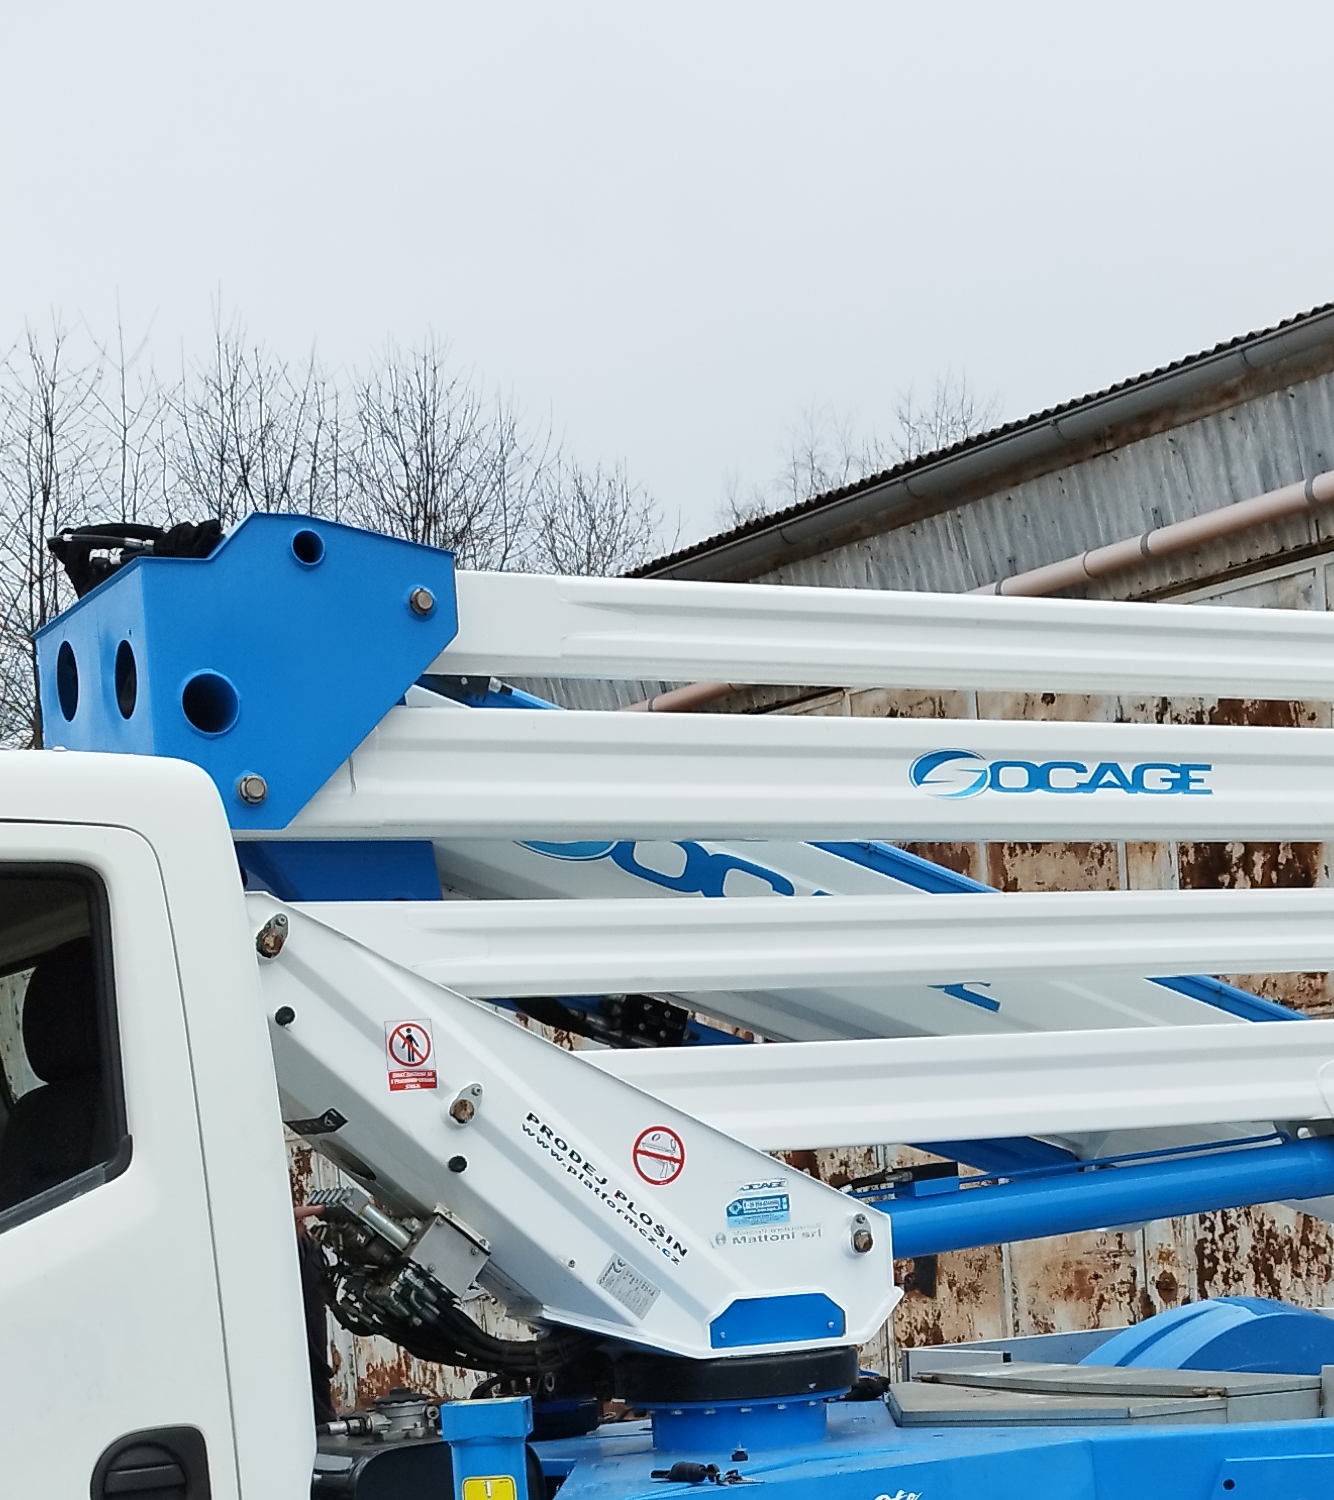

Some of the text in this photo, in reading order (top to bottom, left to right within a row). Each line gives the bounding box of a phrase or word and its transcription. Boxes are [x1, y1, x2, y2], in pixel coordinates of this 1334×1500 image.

[909, 747, 1214, 800] SOCAGE
[521, 1122, 682, 1267] www.platformcz.cz
[525, 1111, 689, 1258] PRODEJ PLOŠIN
[732, 1228, 822, 1245] Mattoni srl
